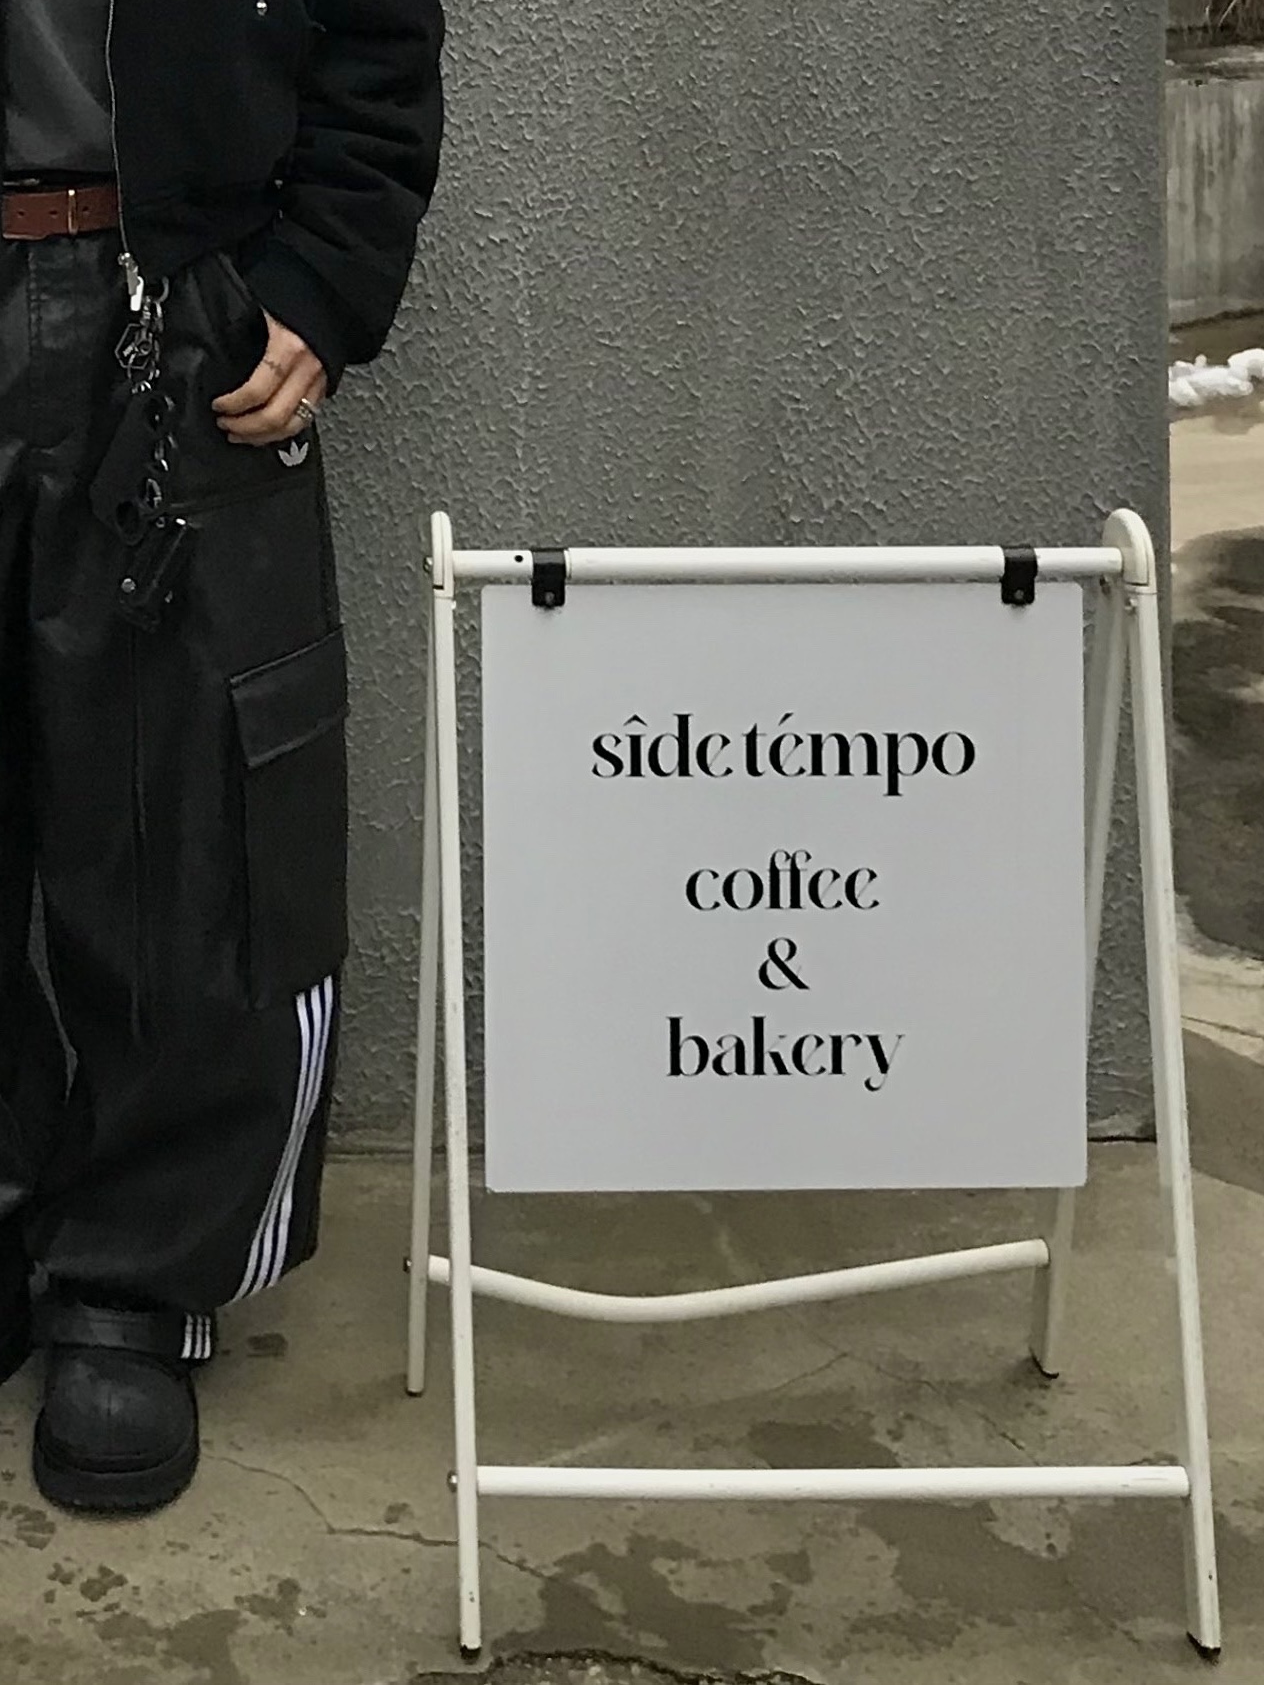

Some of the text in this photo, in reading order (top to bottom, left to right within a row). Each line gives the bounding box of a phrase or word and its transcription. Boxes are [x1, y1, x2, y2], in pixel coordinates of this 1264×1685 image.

[685, 848, 880, 911] coffee
[758, 937, 810, 991] &
[666, 1015, 905, 1092] bakery
